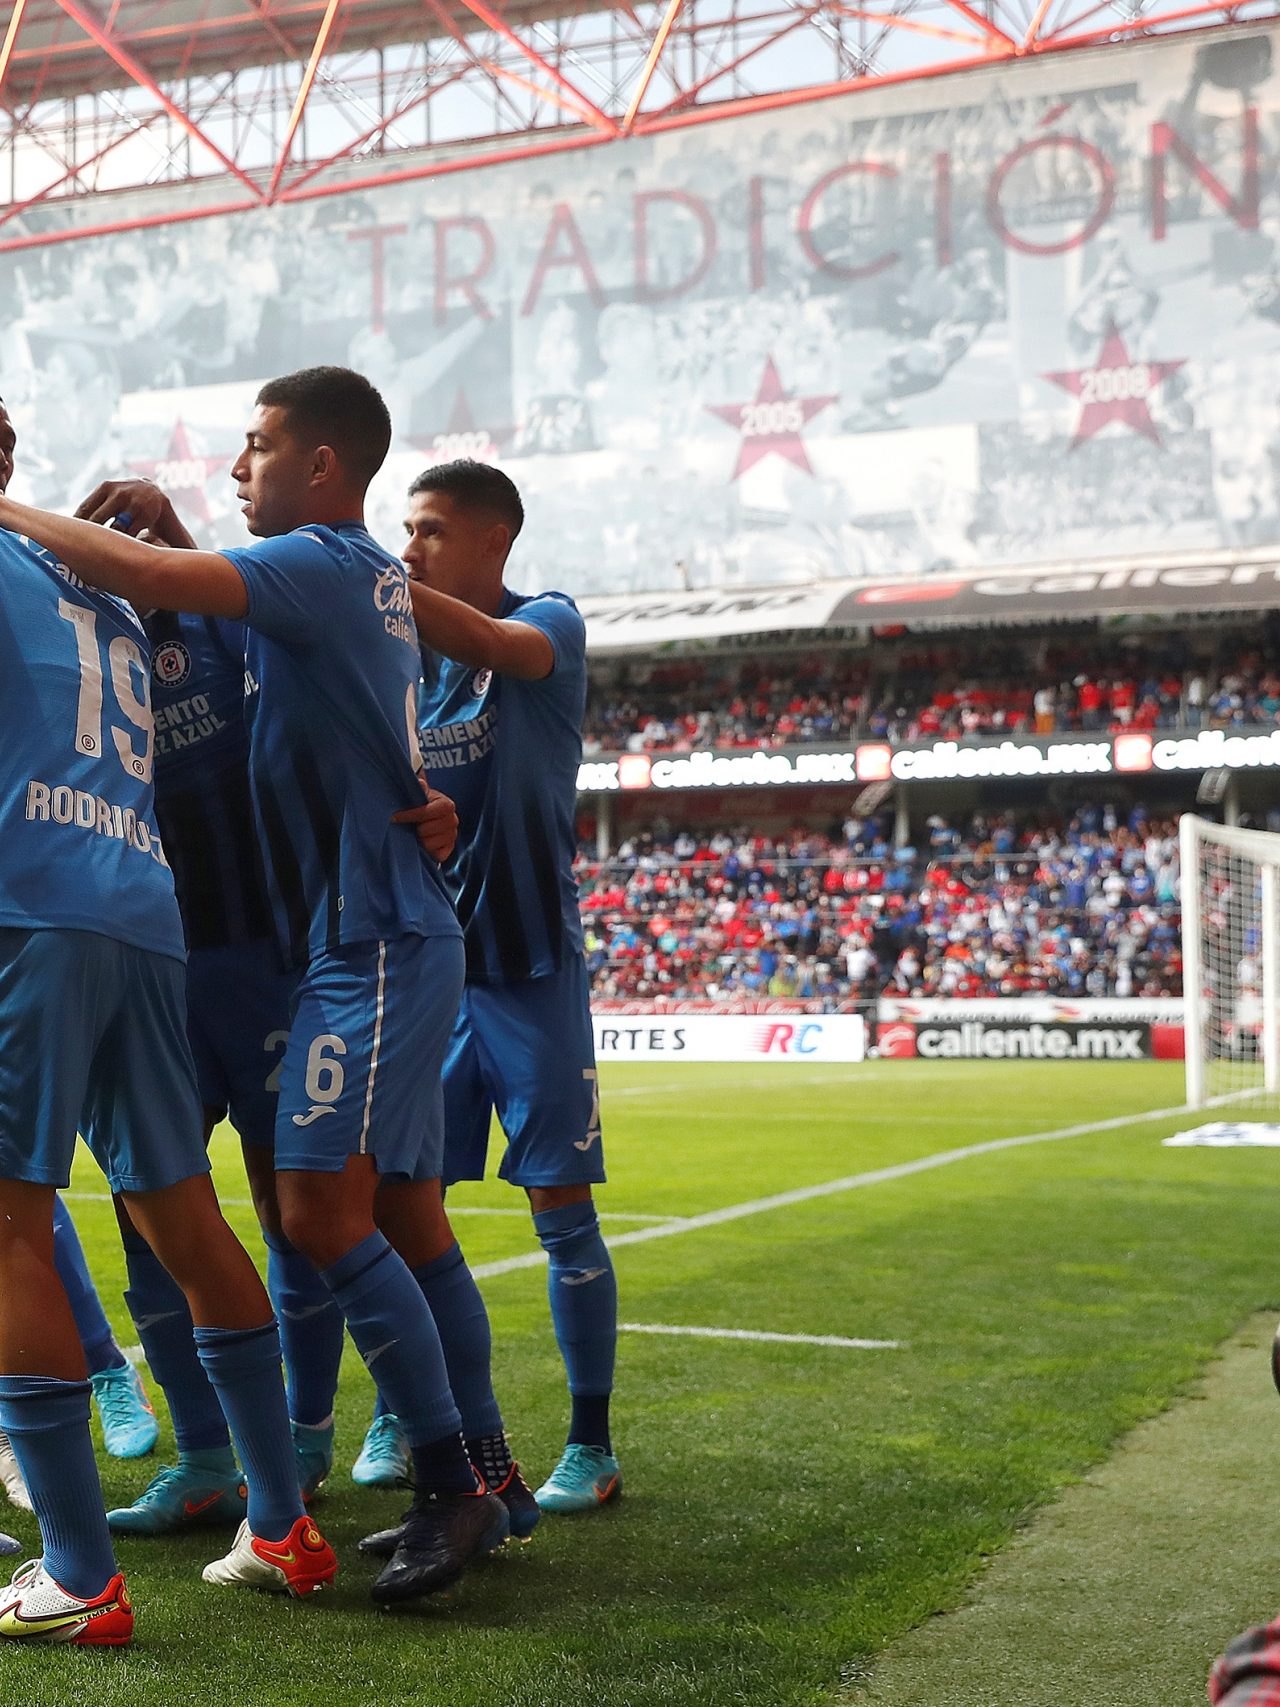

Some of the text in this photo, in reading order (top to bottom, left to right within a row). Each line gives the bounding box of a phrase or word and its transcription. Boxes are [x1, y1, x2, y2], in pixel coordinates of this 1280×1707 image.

[346, 104, 1260, 334] TRADICIÓN
[740, 400, 803, 435] 2005
[58, 597, 155, 785] 19
[171, 713, 227, 750] AZUL
[422, 747, 468, 770] CRUZ
[757, 1023, 823, 1054] RC
[917, 1022, 1144, 1059] caliente.mx
[305, 1033, 347, 1103] 6
[78, 1606, 113, 1622] TIEMPO
